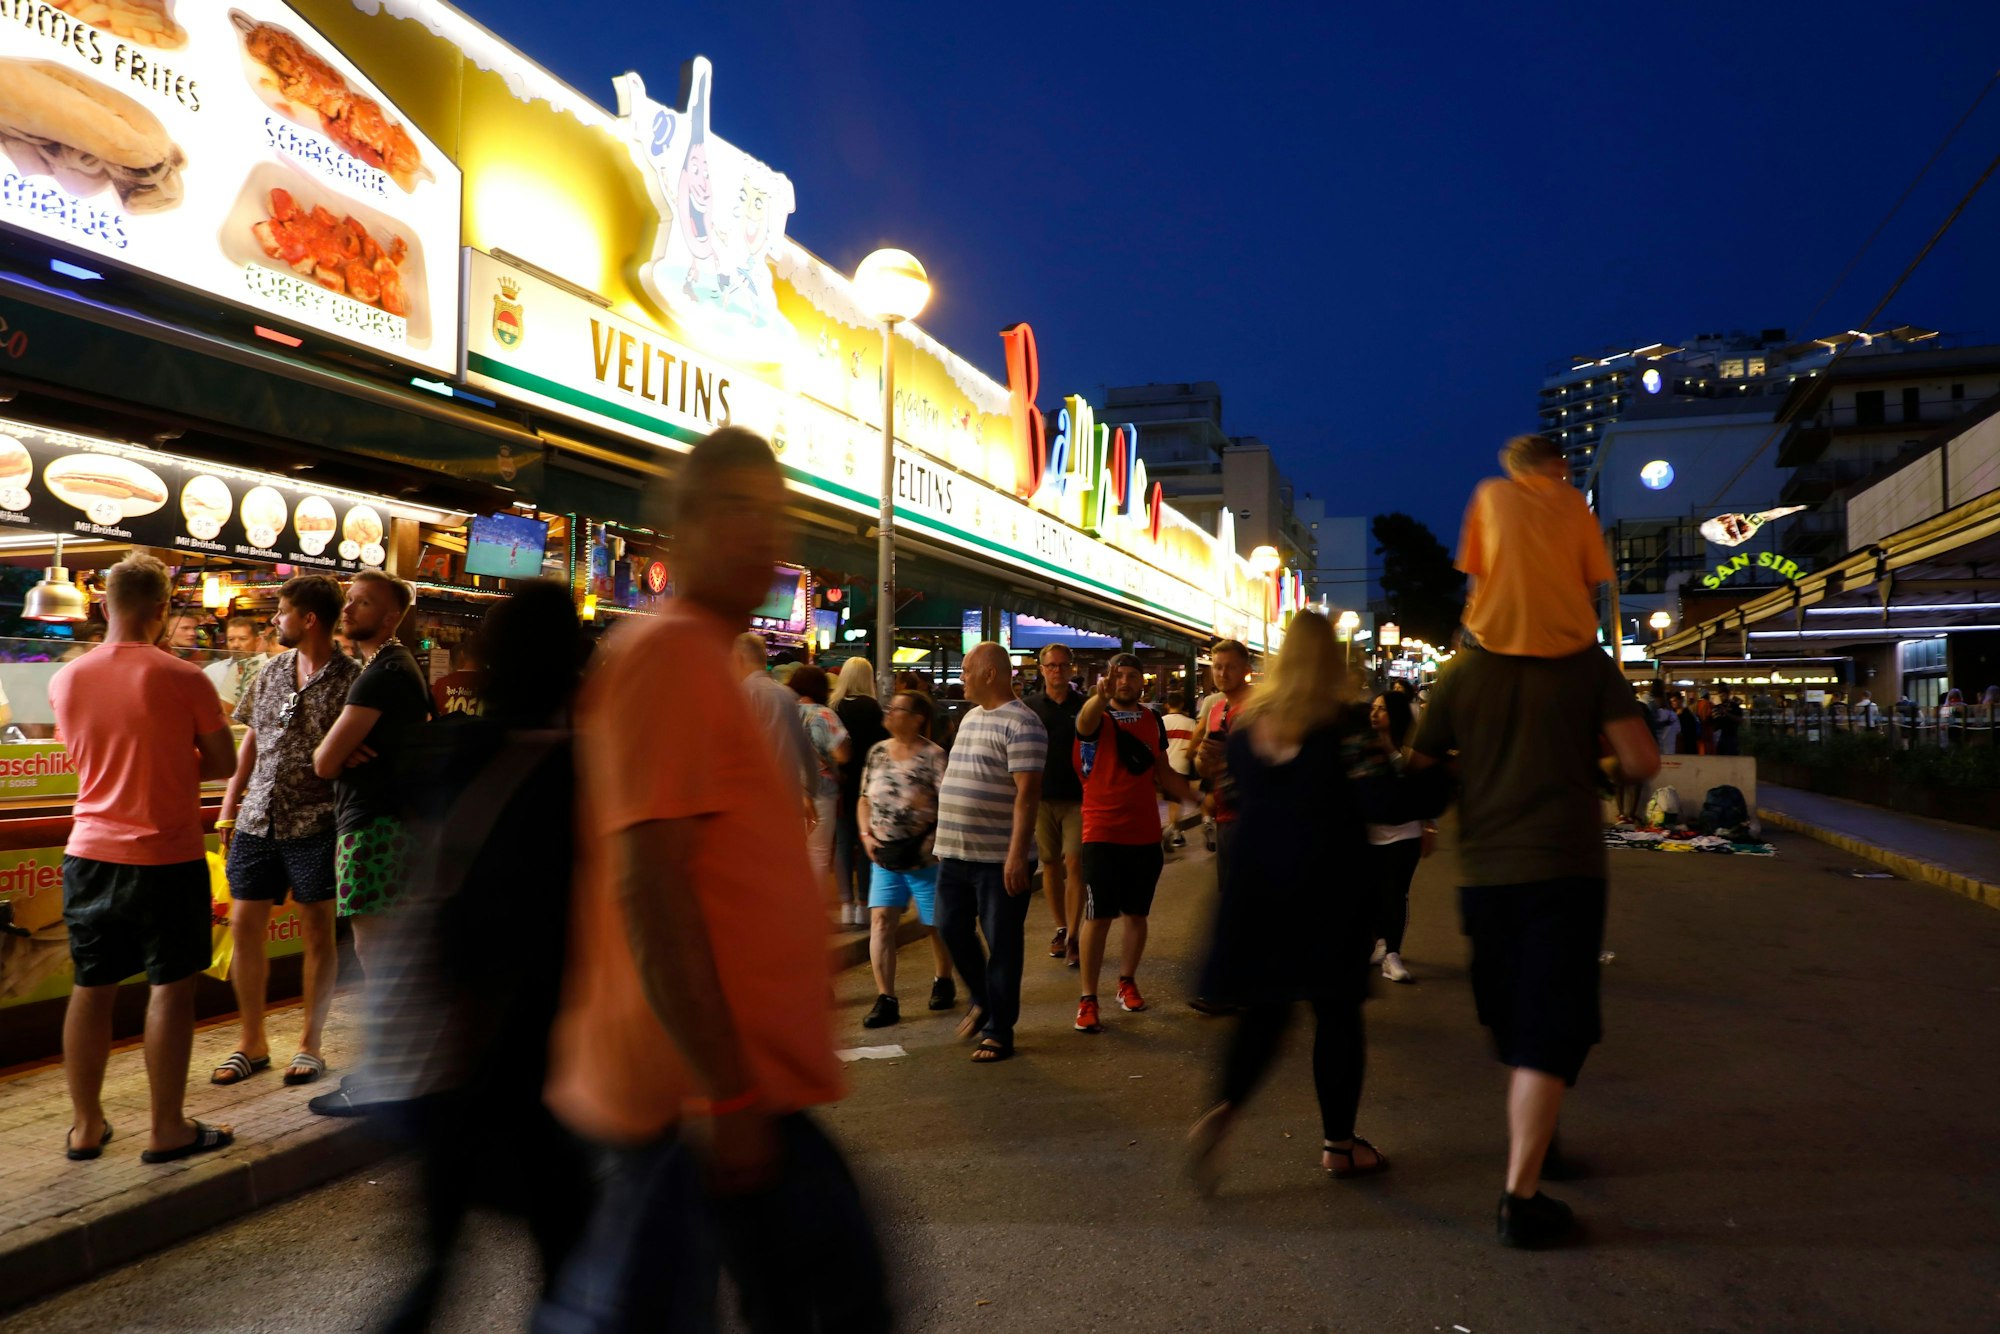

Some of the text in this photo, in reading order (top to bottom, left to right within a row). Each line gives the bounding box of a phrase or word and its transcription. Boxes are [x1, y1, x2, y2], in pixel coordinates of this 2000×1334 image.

[114, 43, 200, 112] FRITES
[589, 317, 731, 428] VELTINS
[91, 523, 132, 538] Brötchen
[1702, 552, 1750, 589] SAN
[0, 752, 76, 777] aschlik
[8, 778, 38, 788] SOSSE
